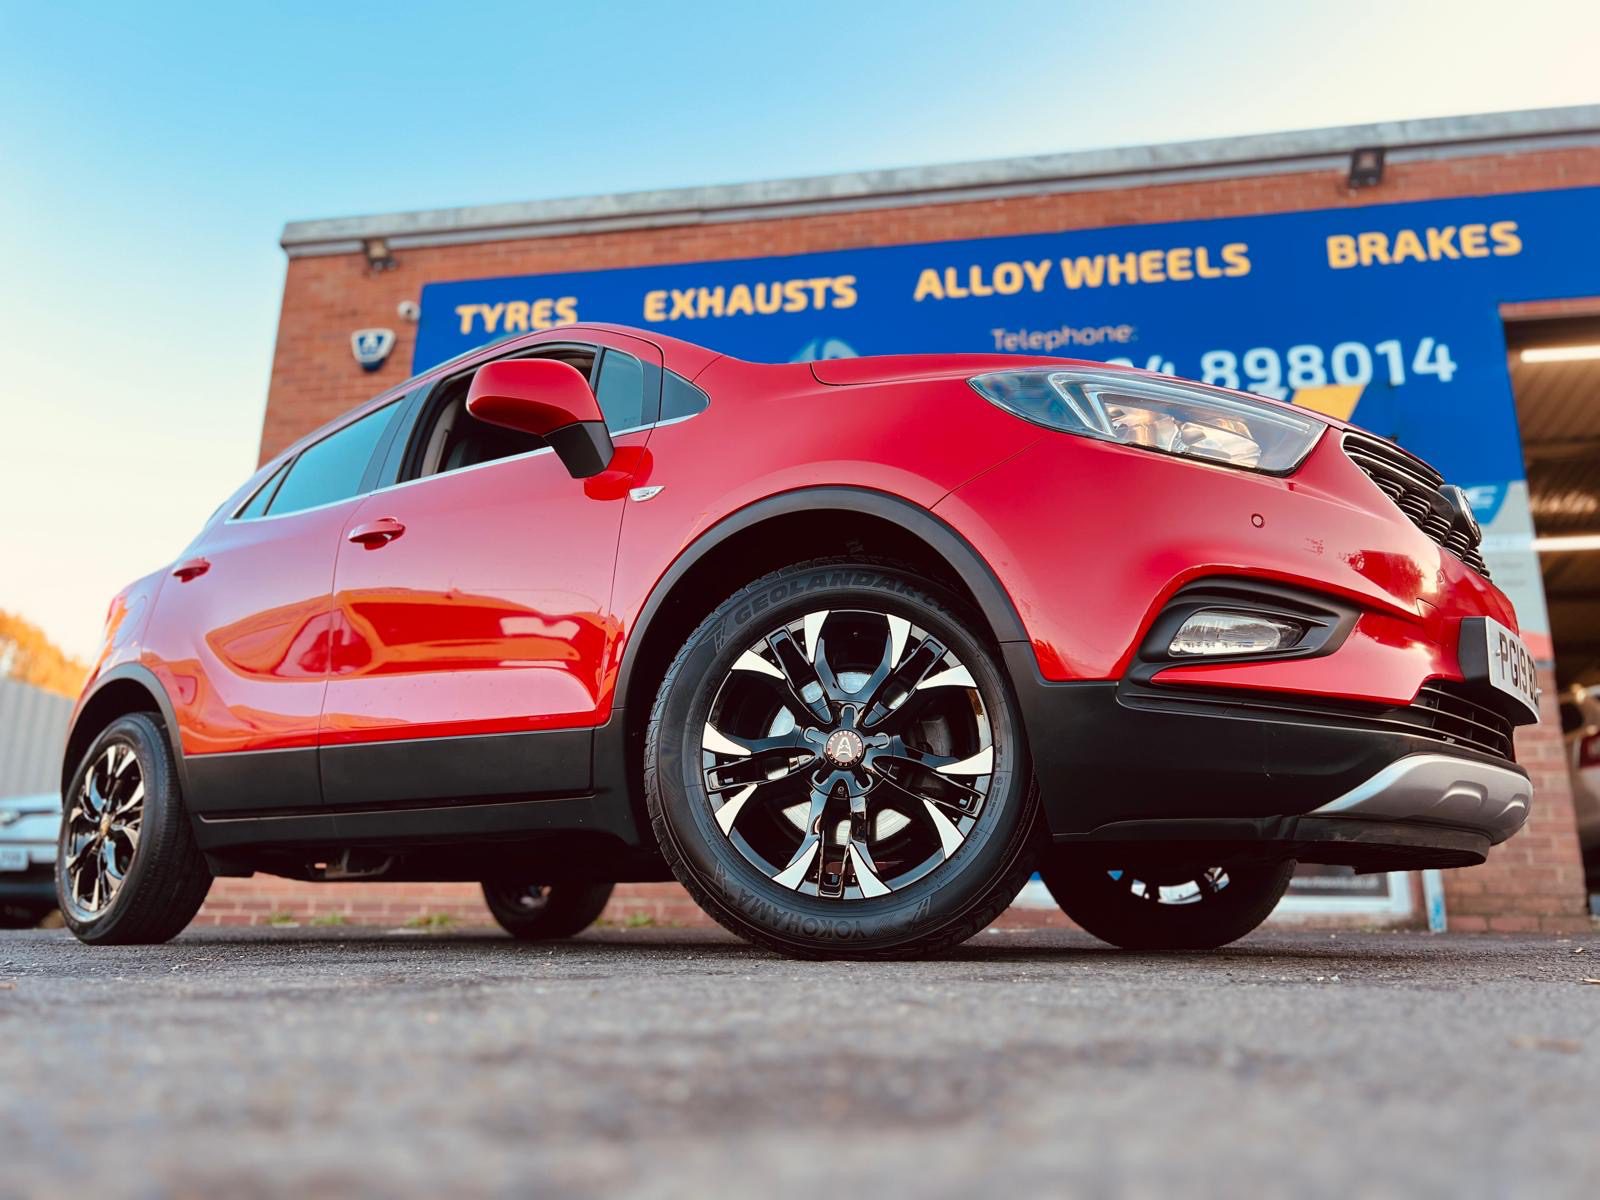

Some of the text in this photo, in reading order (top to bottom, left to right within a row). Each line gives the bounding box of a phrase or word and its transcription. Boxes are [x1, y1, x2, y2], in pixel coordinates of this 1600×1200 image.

[1326, 221, 1522, 269] BRAKES
[913, 243, 1251, 302] ALLOY WHEELS
[455, 296, 578, 334] TYRES
[643, 275, 858, 322] EXHAUSTS
[1200, 337, 1457, 391] 898014
[732, 888, 867, 941] YOKOHAMA
